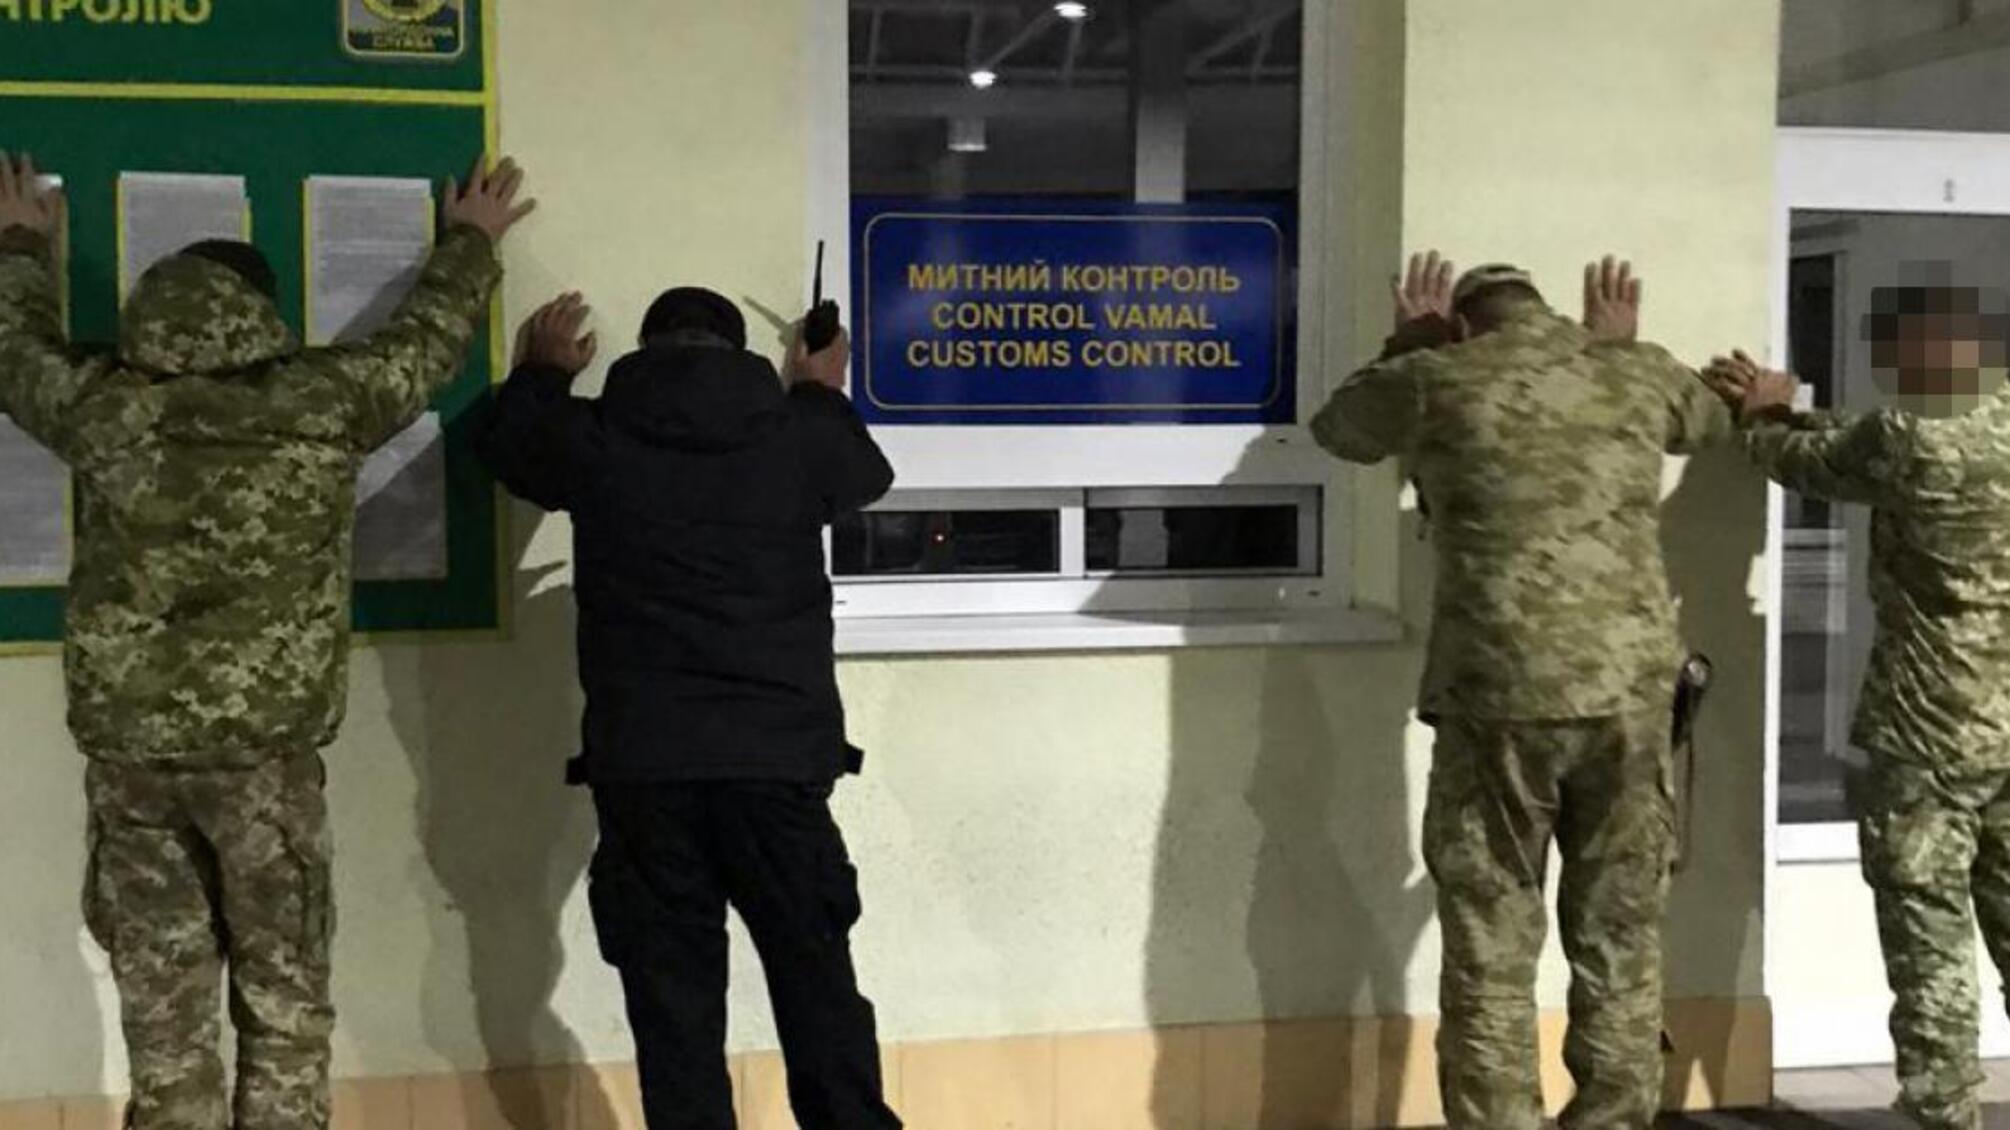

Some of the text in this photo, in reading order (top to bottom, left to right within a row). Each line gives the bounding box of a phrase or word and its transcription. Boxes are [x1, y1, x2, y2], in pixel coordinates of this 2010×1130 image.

[908, 259, 1240, 291] МИТНИЙ КОНТРОЛЬ
[932, 302, 1216, 330] CONTROL VAMAL
[907, 340, 1241, 367] CUSTOMS CONTROL
